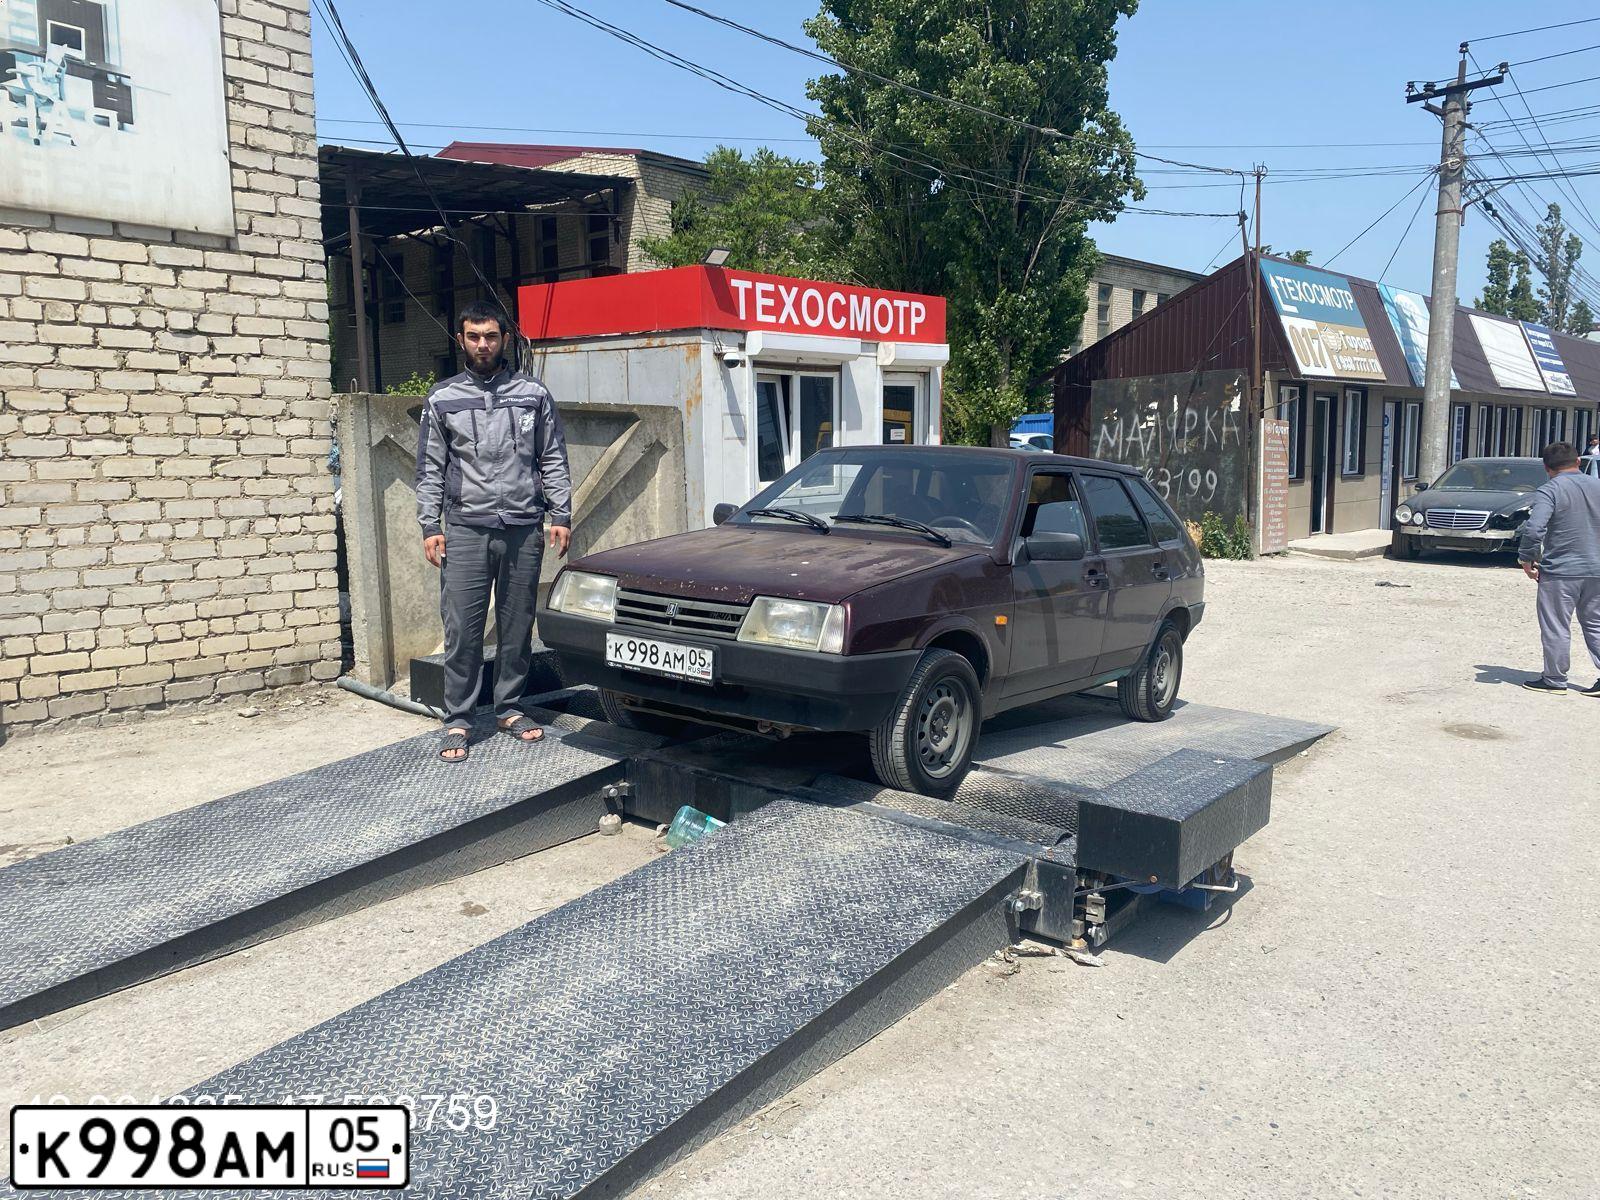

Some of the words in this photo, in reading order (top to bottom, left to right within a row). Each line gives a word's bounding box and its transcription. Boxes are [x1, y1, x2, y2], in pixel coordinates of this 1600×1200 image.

[731, 278, 926, 335] ТЕХОСМОТР
[1275, 275, 1354, 311] ТЕХОСМОТР
[1289, 324, 1328, 369] 017
[1338, 330, 1373, 353] Гарант
[1096, 405, 1240, 460] МАЛЯРКА
[614, 640, 685, 671] К998АМ
[688, 649, 707, 668] 05
[687, 666, 700, 674] RUS
